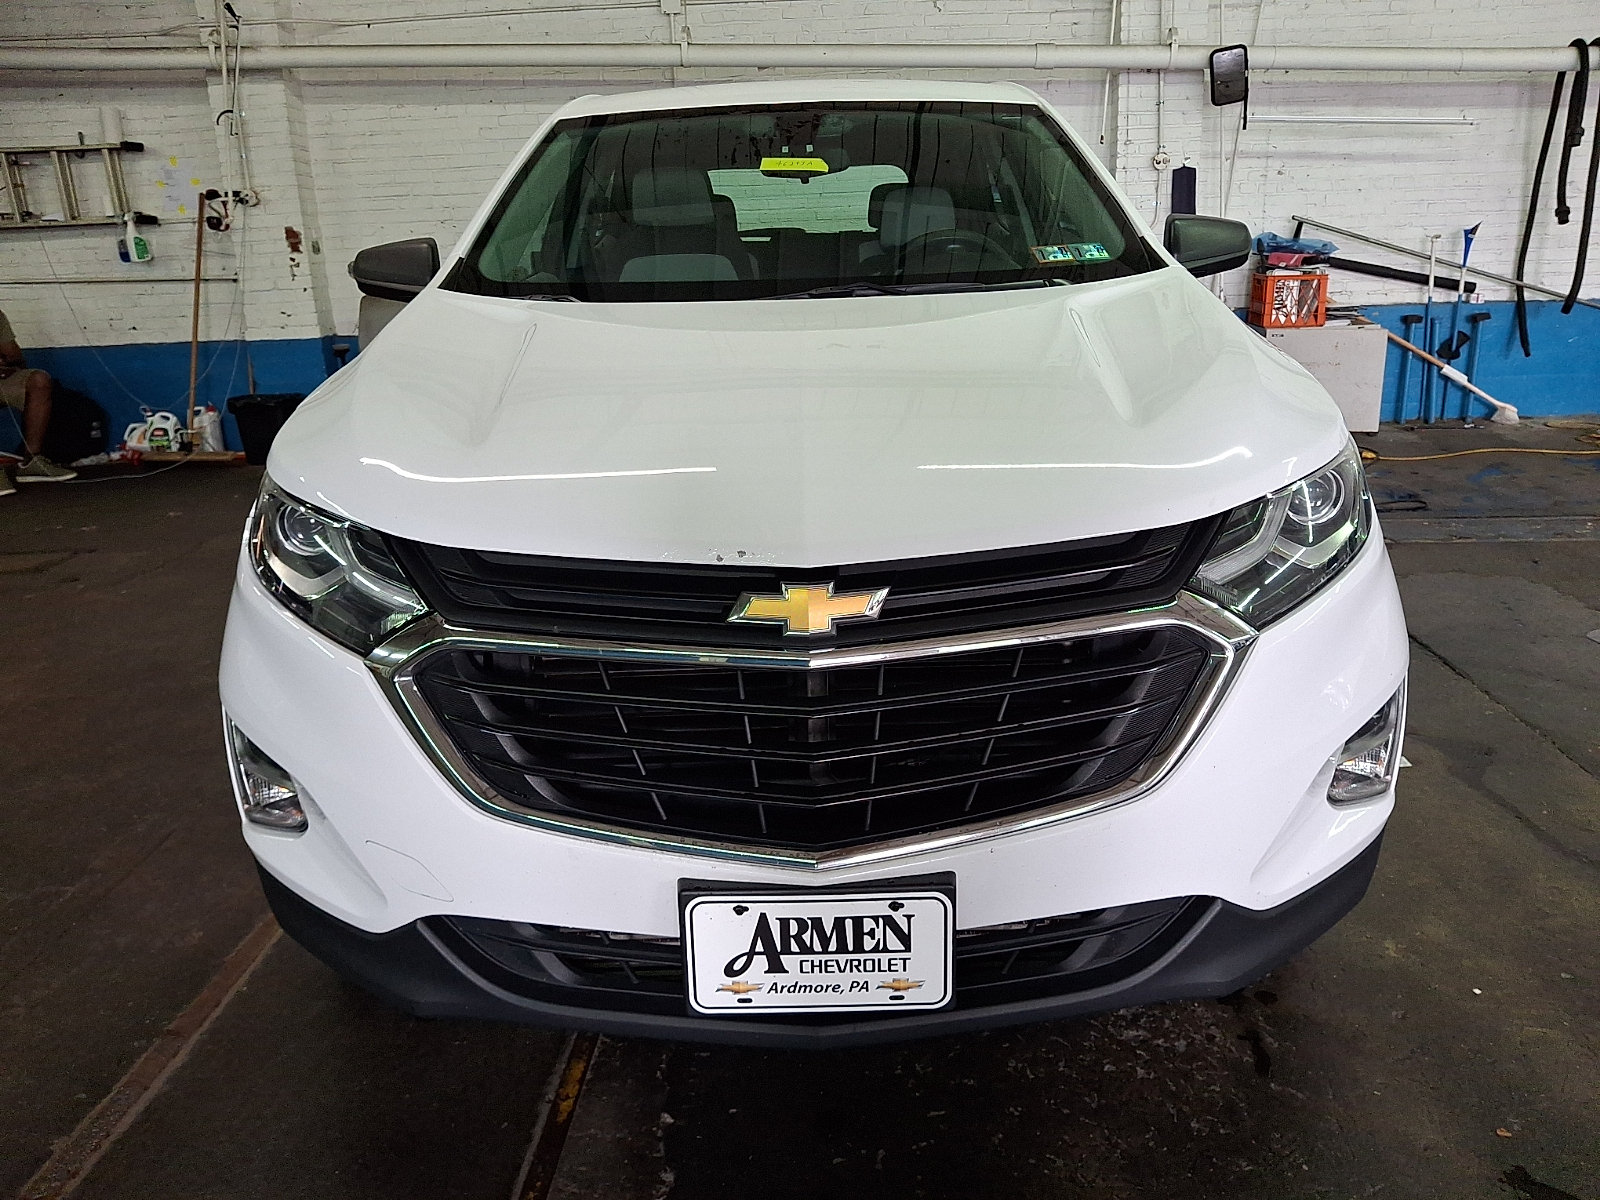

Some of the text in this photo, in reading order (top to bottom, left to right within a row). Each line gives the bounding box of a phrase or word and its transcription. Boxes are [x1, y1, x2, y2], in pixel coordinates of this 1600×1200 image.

[723, 912, 916, 978] ARMEN
[799, 957, 912, 974] CHEVROLET
[767, 980, 870, 995] Ardmore, PA
